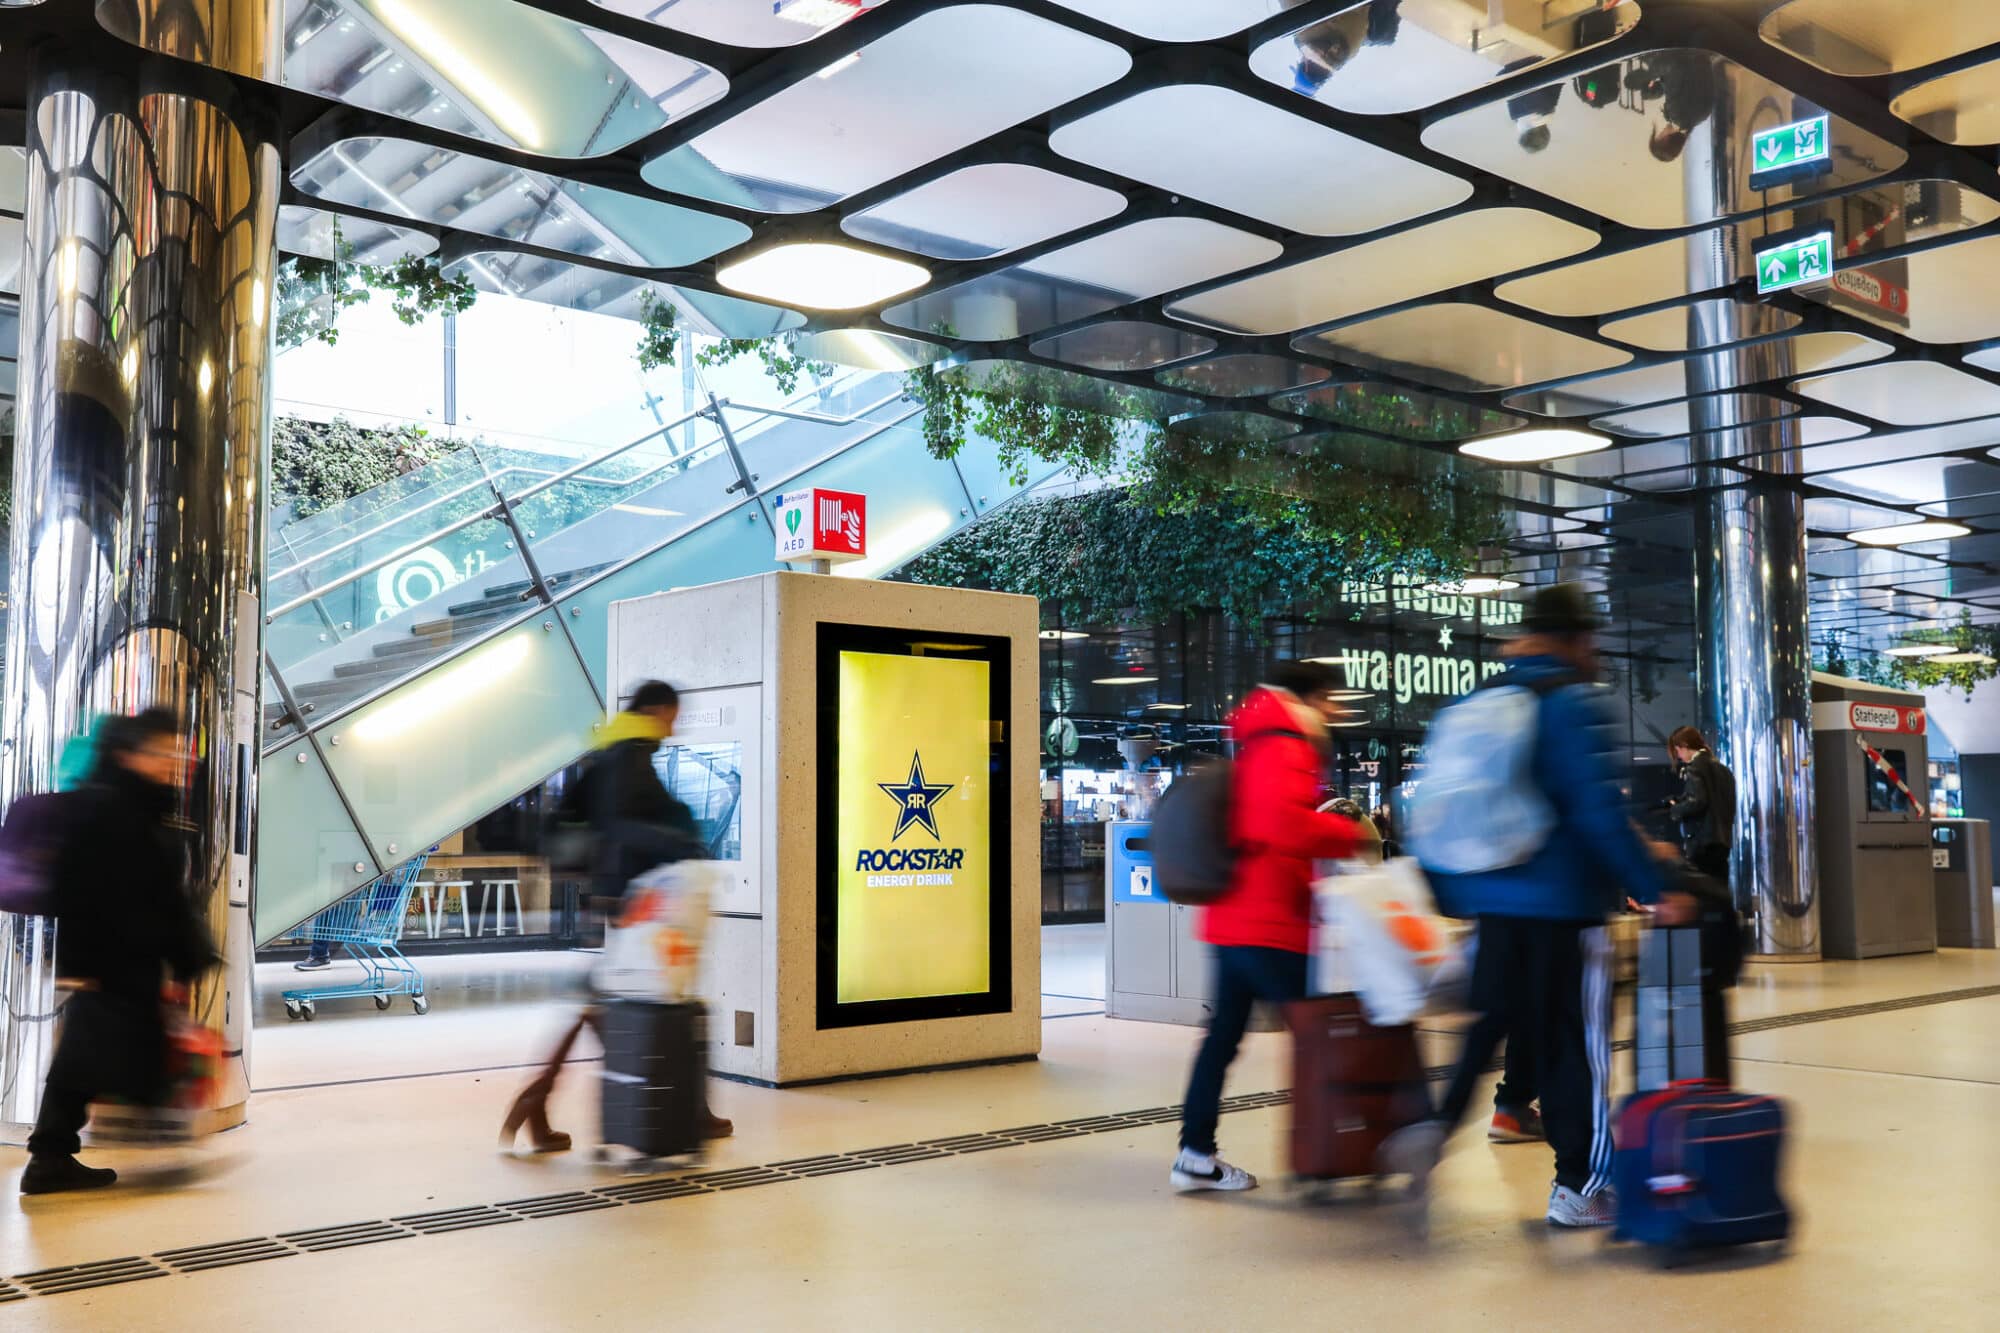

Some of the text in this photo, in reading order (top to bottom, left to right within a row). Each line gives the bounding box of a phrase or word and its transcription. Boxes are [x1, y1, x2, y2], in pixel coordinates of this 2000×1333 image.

[783, 538, 805, 552] AED
[1855, 707, 1896, 727] Statiegeld
[856, 849, 964, 872] ROCKSTAR
[866, 873, 953, 888] ENERGY DRINK
